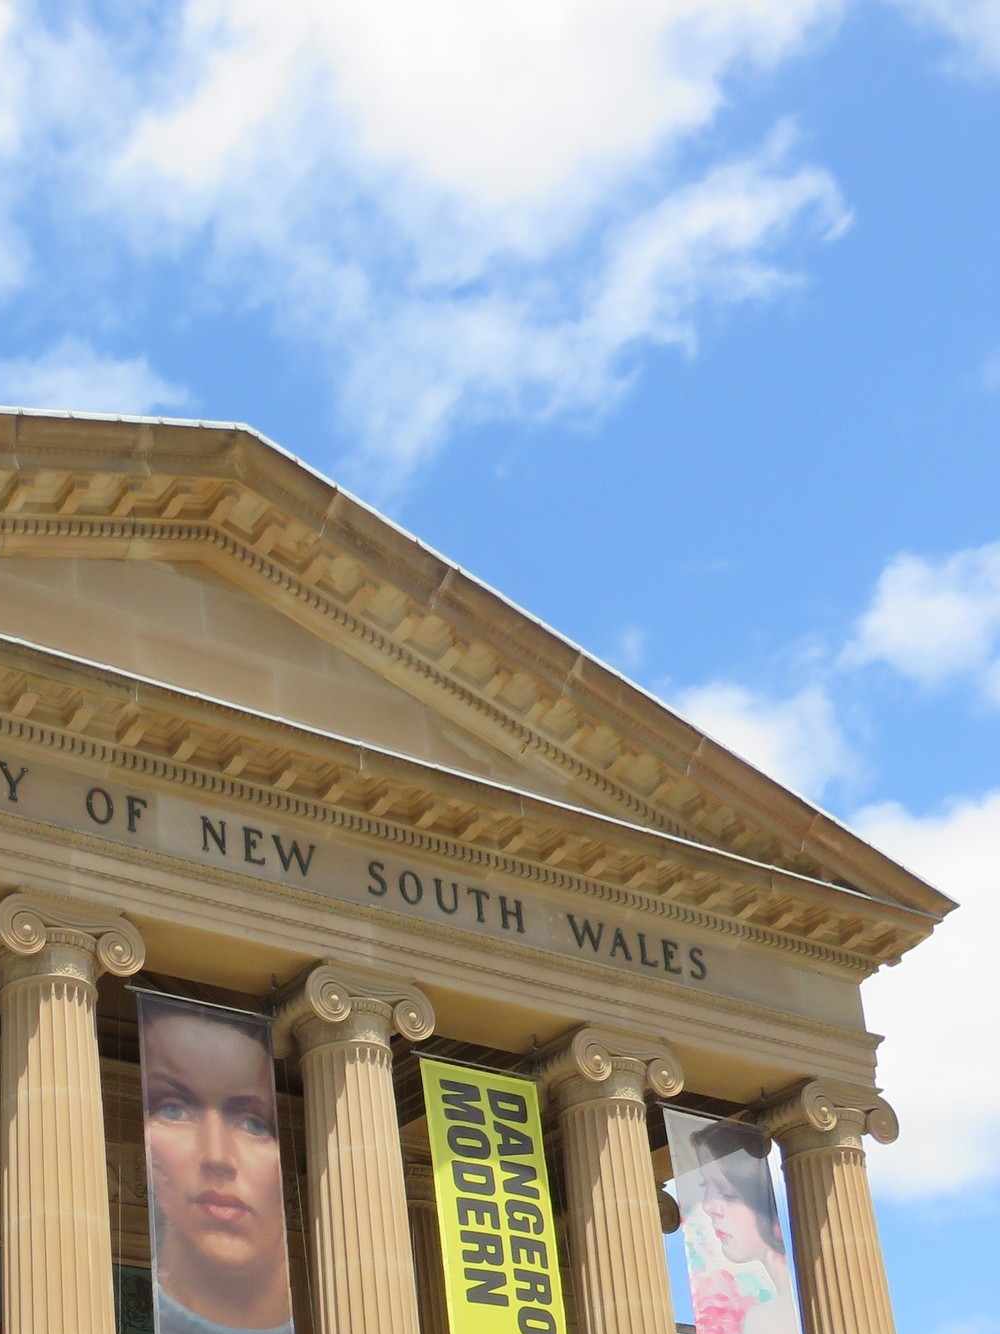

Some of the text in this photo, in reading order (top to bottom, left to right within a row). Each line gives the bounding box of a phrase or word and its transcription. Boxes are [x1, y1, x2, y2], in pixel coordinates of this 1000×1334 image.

[85, 787, 148, 832] OF
[200, 815, 316, 877] NEW
[368, 861, 525, 934] SOUTH
[566, 913, 708, 981] WALES
[438, 1078, 510, 1308] MODERN
